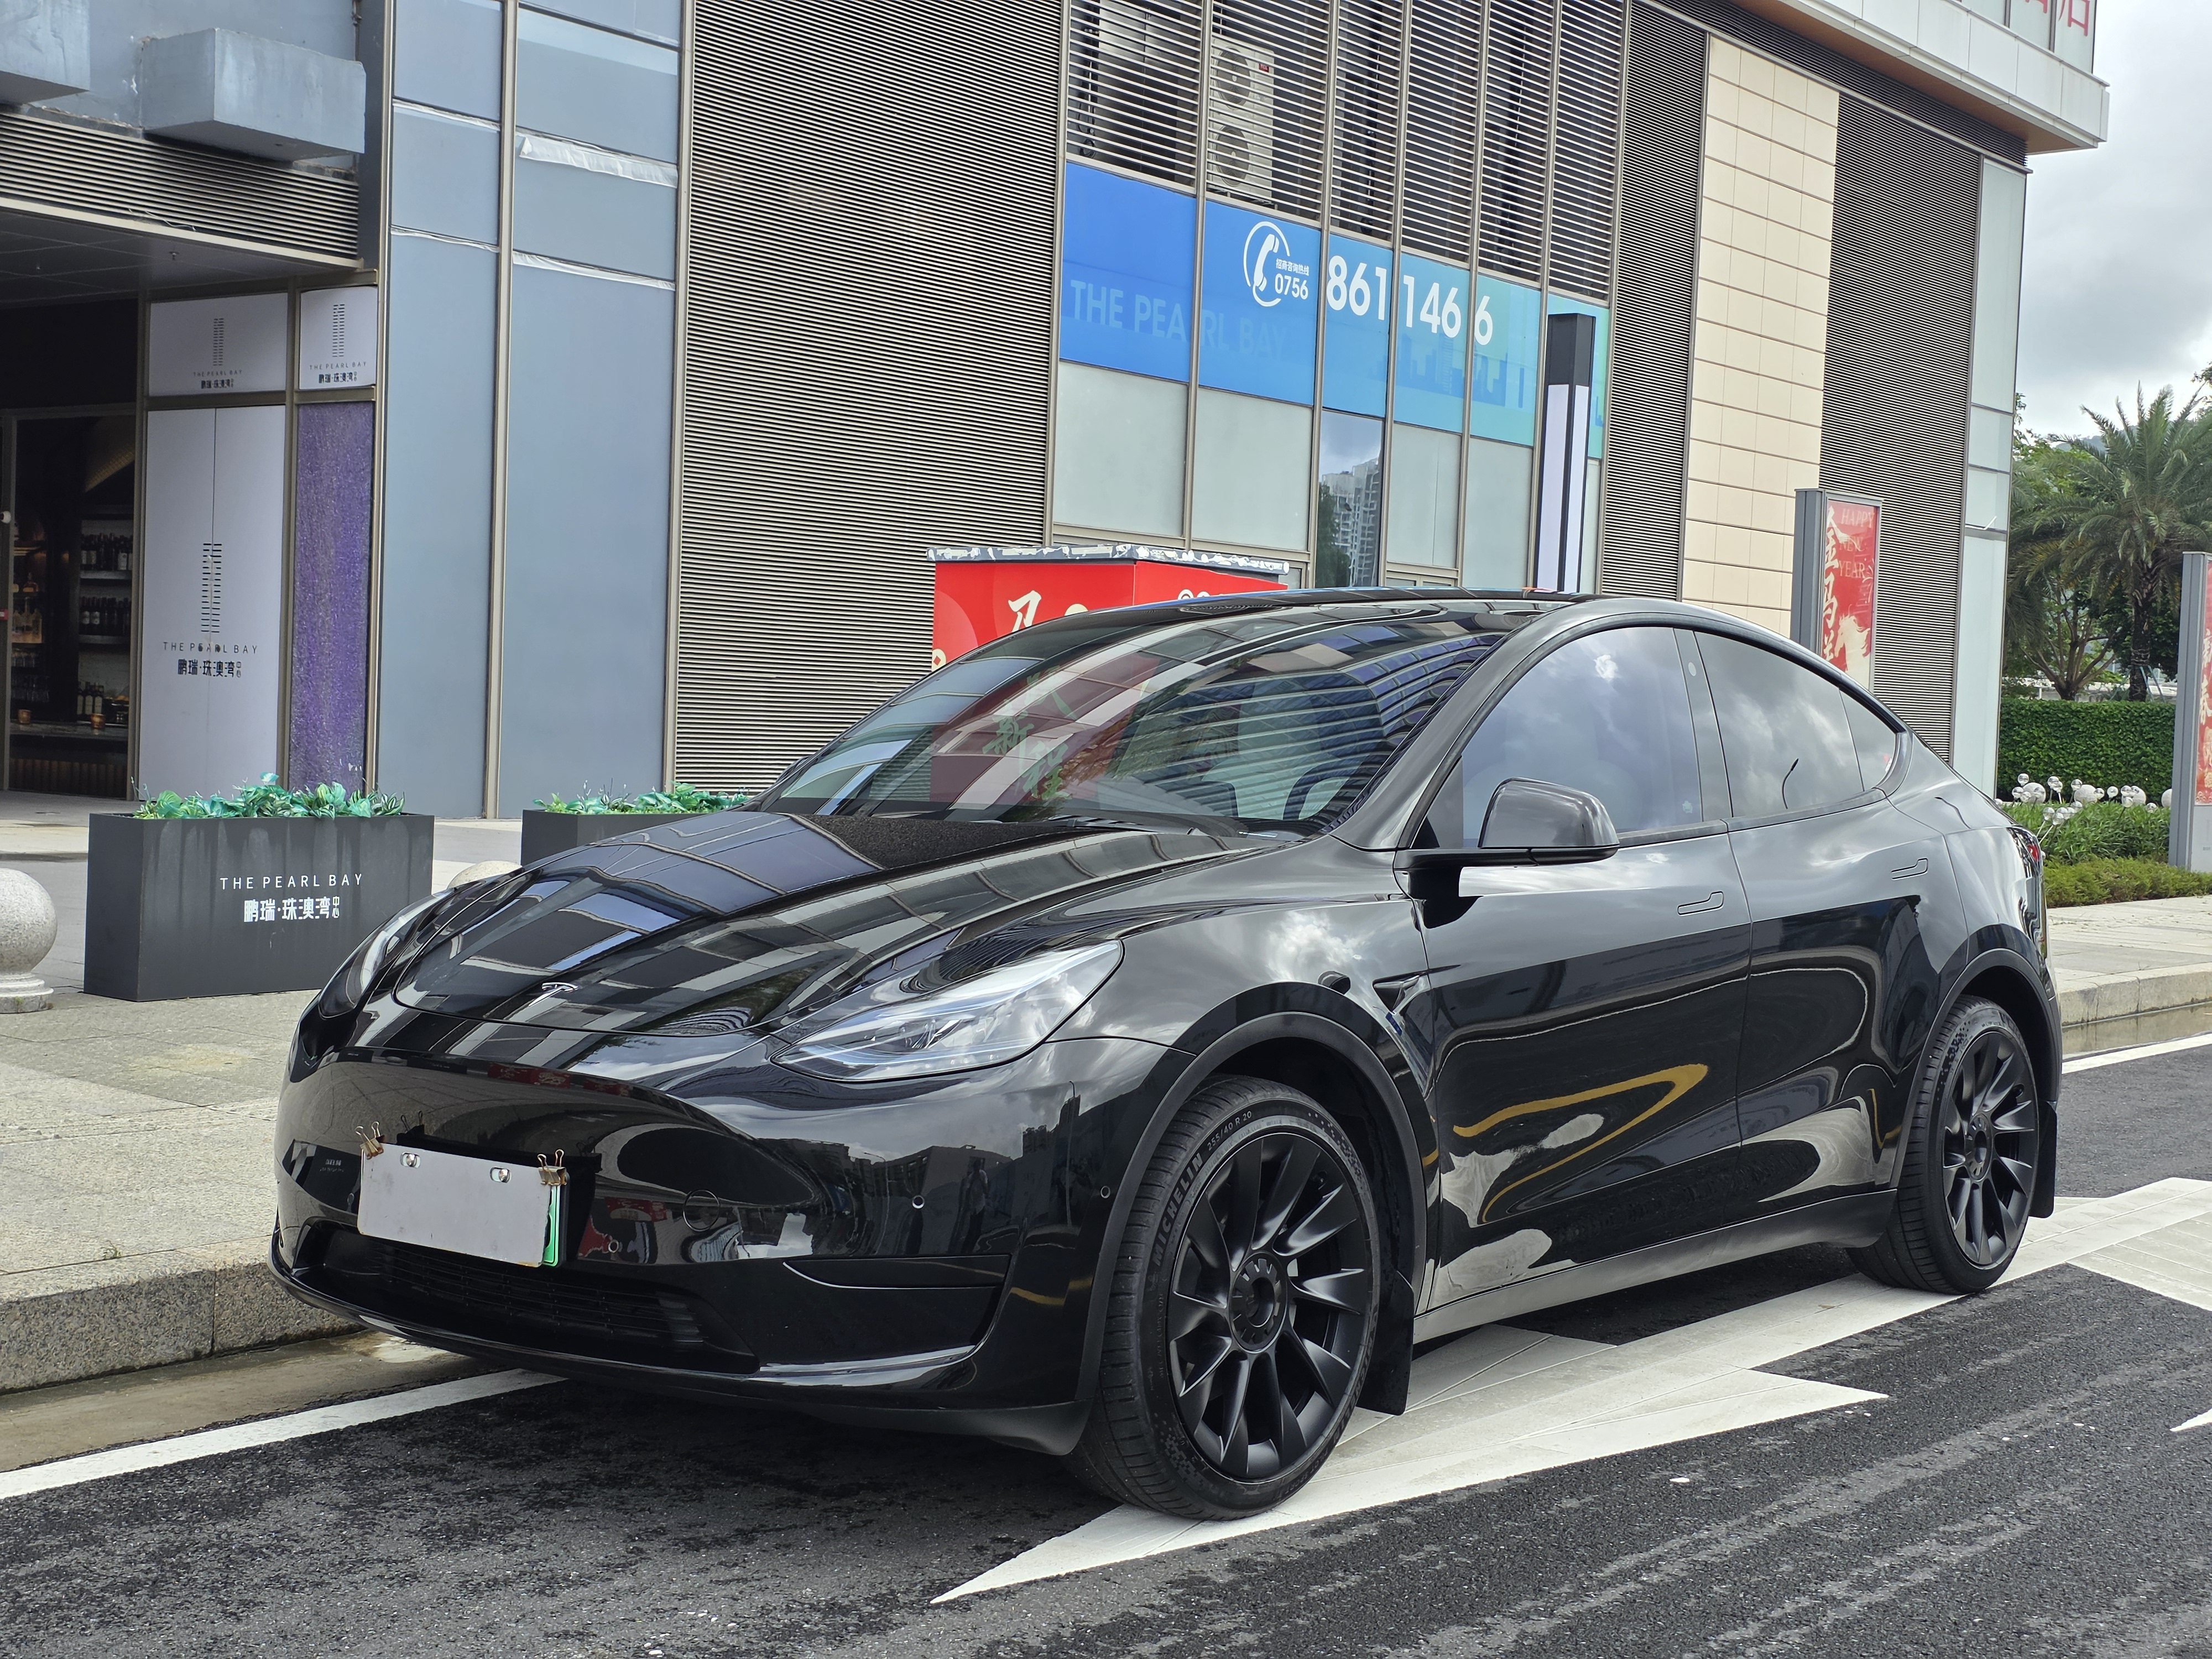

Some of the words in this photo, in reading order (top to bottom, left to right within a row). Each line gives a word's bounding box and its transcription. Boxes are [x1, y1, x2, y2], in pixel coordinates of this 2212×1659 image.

[1276, 258, 1310, 276] 招商咨询热线
[1275, 273, 1309, 300] 0756
[1071, 279, 1124, 328] THE
[1239, 317, 1287, 363] BAY
[1841, 508, 1875, 528] HAPPY
[1838, 560, 1866, 579] YEAR
[164, 641, 184, 651] THE
[190, 643, 227, 654] PEARL
[234, 645, 257, 654] BAY
[220, 877, 254, 890] THE
[263, 875, 320, 889] PEARL
[329, 874, 362, 886] BAY
[1152, 1152, 1203, 1267] MICHELIN
[1207, 1122, 1233, 1151] 255/40
[1243, 1110, 1252, 1121] 20
